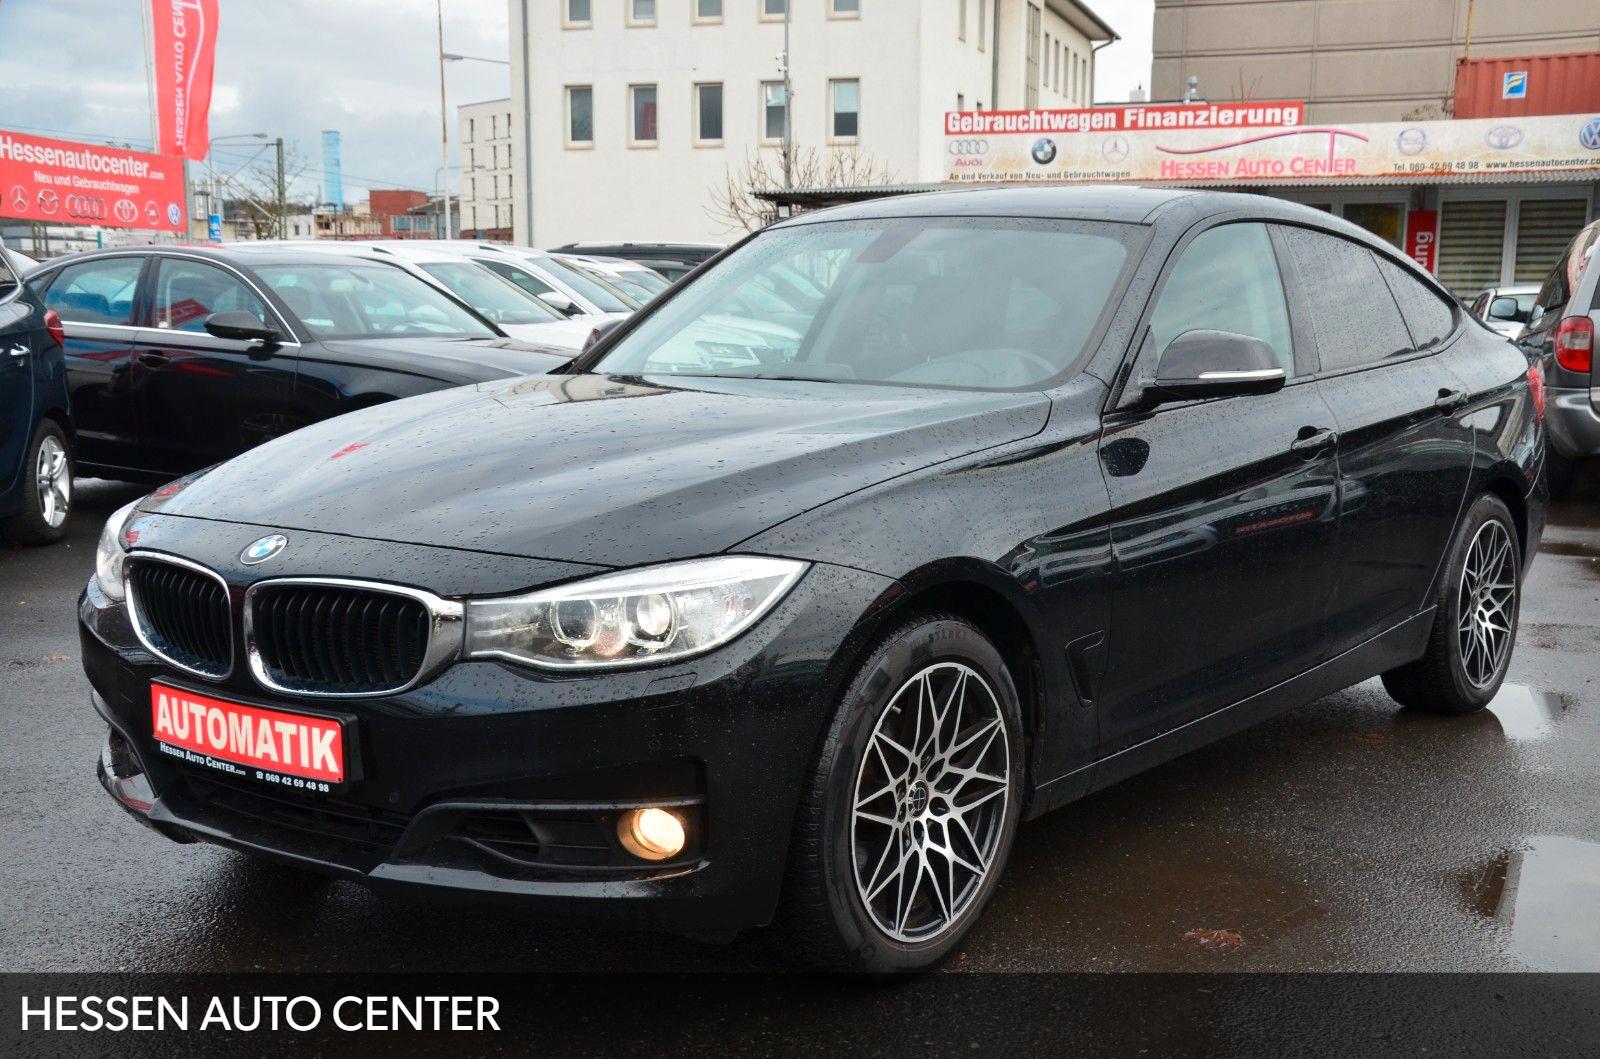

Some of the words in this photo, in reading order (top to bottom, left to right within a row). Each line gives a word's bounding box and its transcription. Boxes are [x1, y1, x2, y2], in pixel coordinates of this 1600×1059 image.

[947, 112, 1117, 132] Gebrauchtwagen
[1123, 106, 1300, 128] Finanzierung
[961, 172, 976, 180] und
[978, 172, 1008, 180] Verkauf
[1046, 171, 1062, 179] und
[1064, 170, 1131, 179] Gebrauchtwagen
[1160, 160, 1230, 177] HESSEN
[1235, 158, 1284, 175] AUTO
[34, 170, 53, 185] Neu
[54, 174, 71, 187] und
[72, 176, 140, 196] Gebrauchtwagen
[156, 693, 340, 773] AUTOMATIK
[160, 741, 185, 759] HESSEN
[185, 750, 205, 765] AUTO
[265, 772, 280, 783] 069
[281, 776, 292, 786] 42
[293, 778, 304, 788] 69
[305, 781, 317, 790] 48
[318, 783, 330, 793] 98
